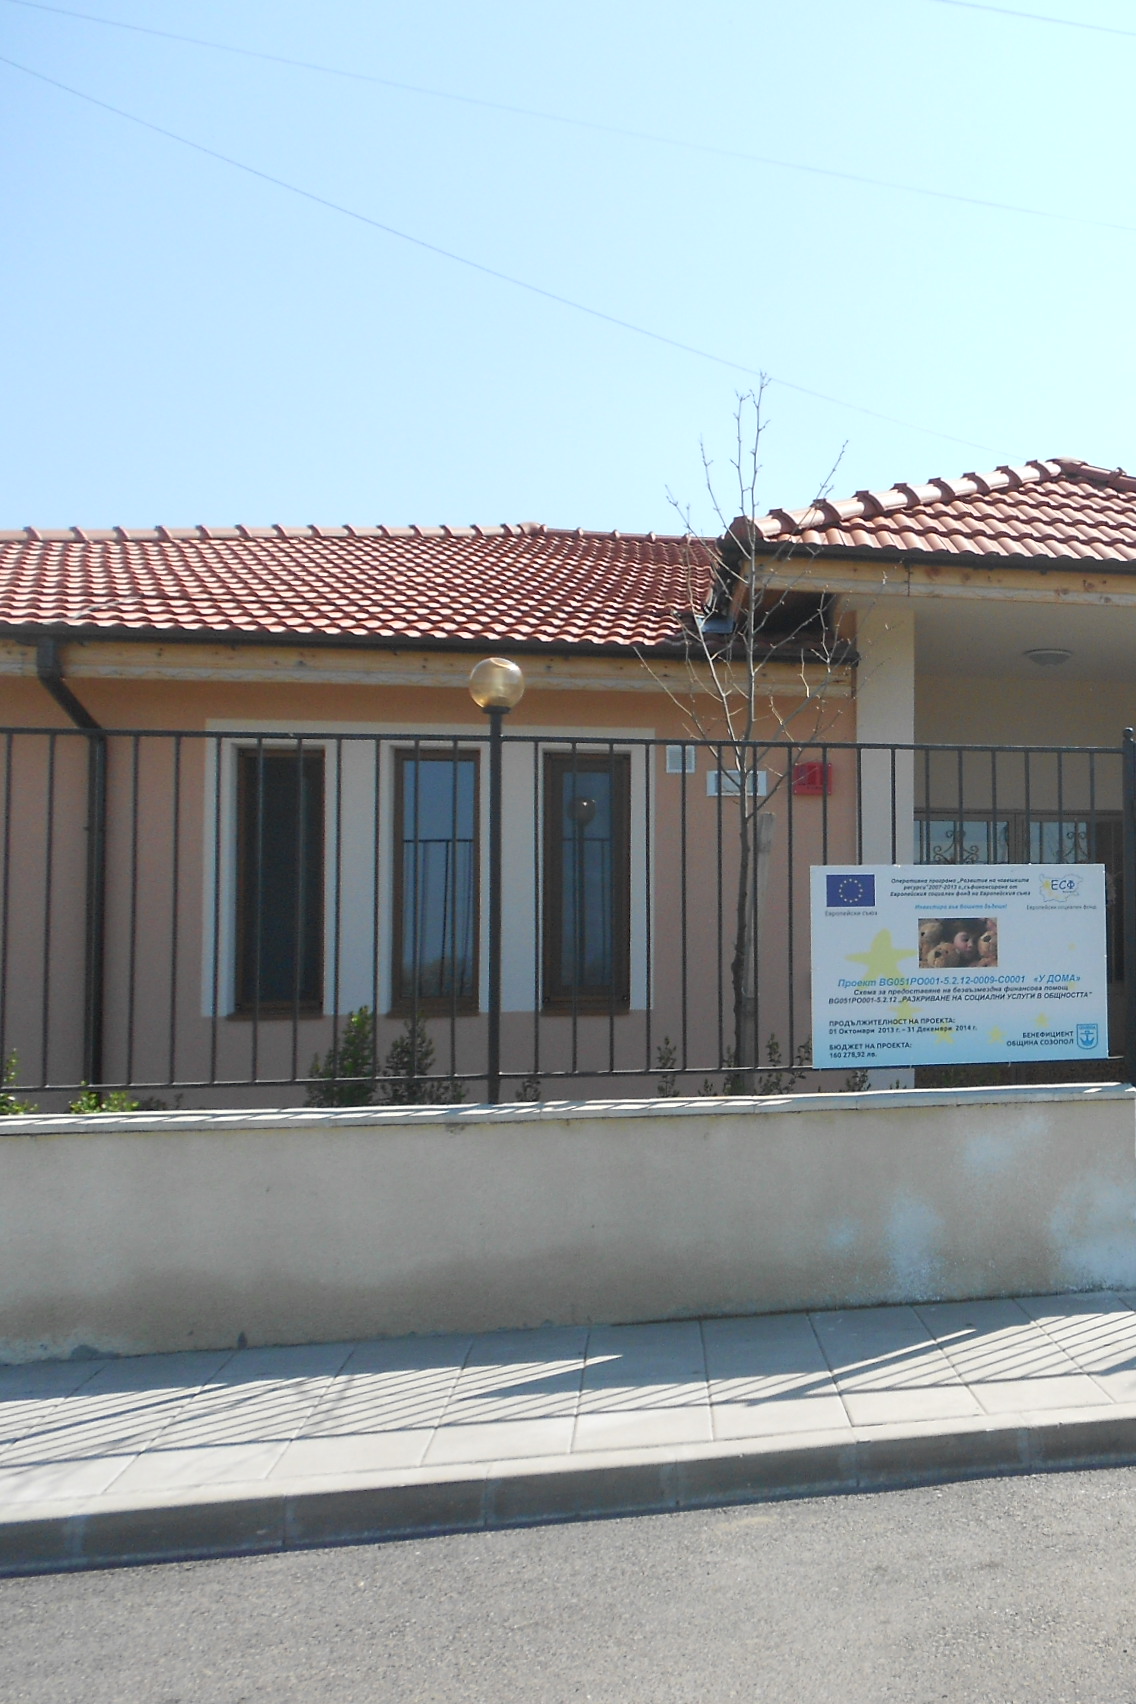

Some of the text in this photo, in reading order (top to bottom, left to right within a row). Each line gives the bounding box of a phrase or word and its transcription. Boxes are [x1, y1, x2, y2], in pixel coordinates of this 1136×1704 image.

[1051, 879, 1075, 890] ЕСФ
[838, 978, 876, 988] Проект
[888, 987, 941, 996] предоставяне
[1003, 985, 1042, 993] финансова
[964, 993, 1006, 1002] СОЦИАЛНИ
[1007, 992, 1035, 1000] УСЛУГИ
[829, 1018, 907, 1028] ПРОДЪЛЖИТЕЛНОСТ
[838, 1027, 875, 1035] Октомври
[1022, 1030, 1074, 1039] БЕНЕФИЦИЕНТ
[829, 1043, 863, 1051] БЮДЖЕТ
[1006, 1038, 1074, 1048] ОБЩИНА СОЗОПОЛ
